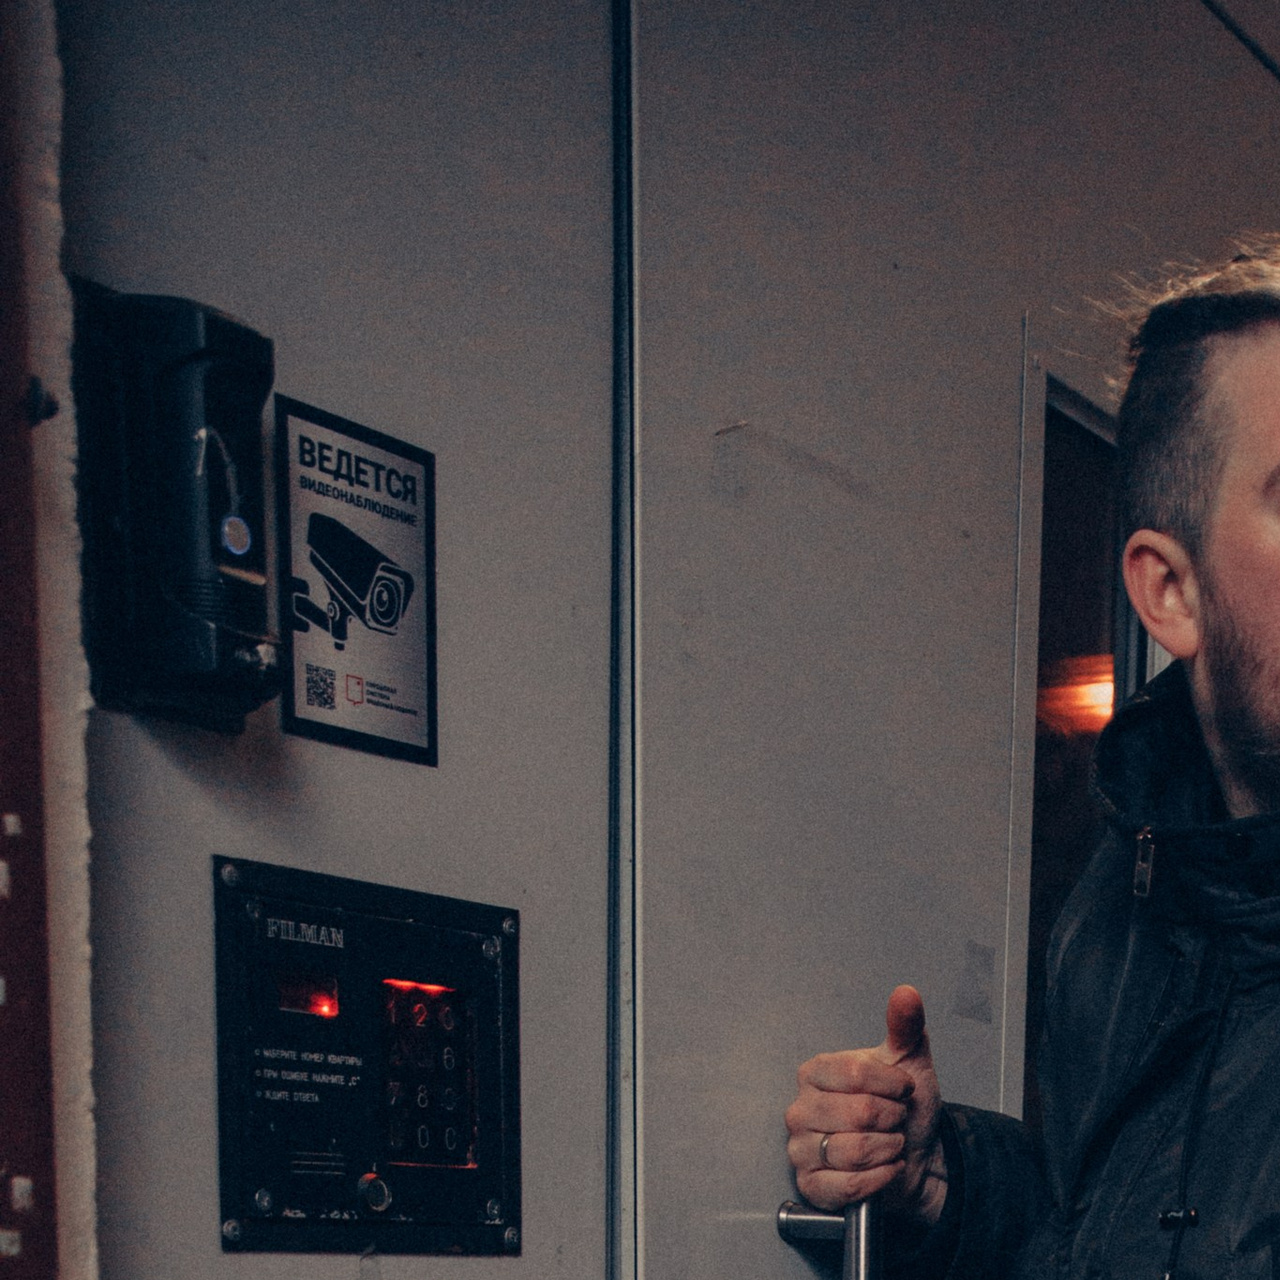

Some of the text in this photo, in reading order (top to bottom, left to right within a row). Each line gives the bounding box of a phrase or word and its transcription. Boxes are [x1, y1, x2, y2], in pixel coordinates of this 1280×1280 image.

[298, 434, 417, 506] ВЕДЕТСЯ
[299, 475, 417, 528] ВИДЕОНАБЛЮДЕНИЕ
[266, 917, 345, 949] FILMAN
[413, 1003, 428, 1028] 2
[443, 1046, 456, 1070] 6
[417, 1084, 429, 1108] 8
